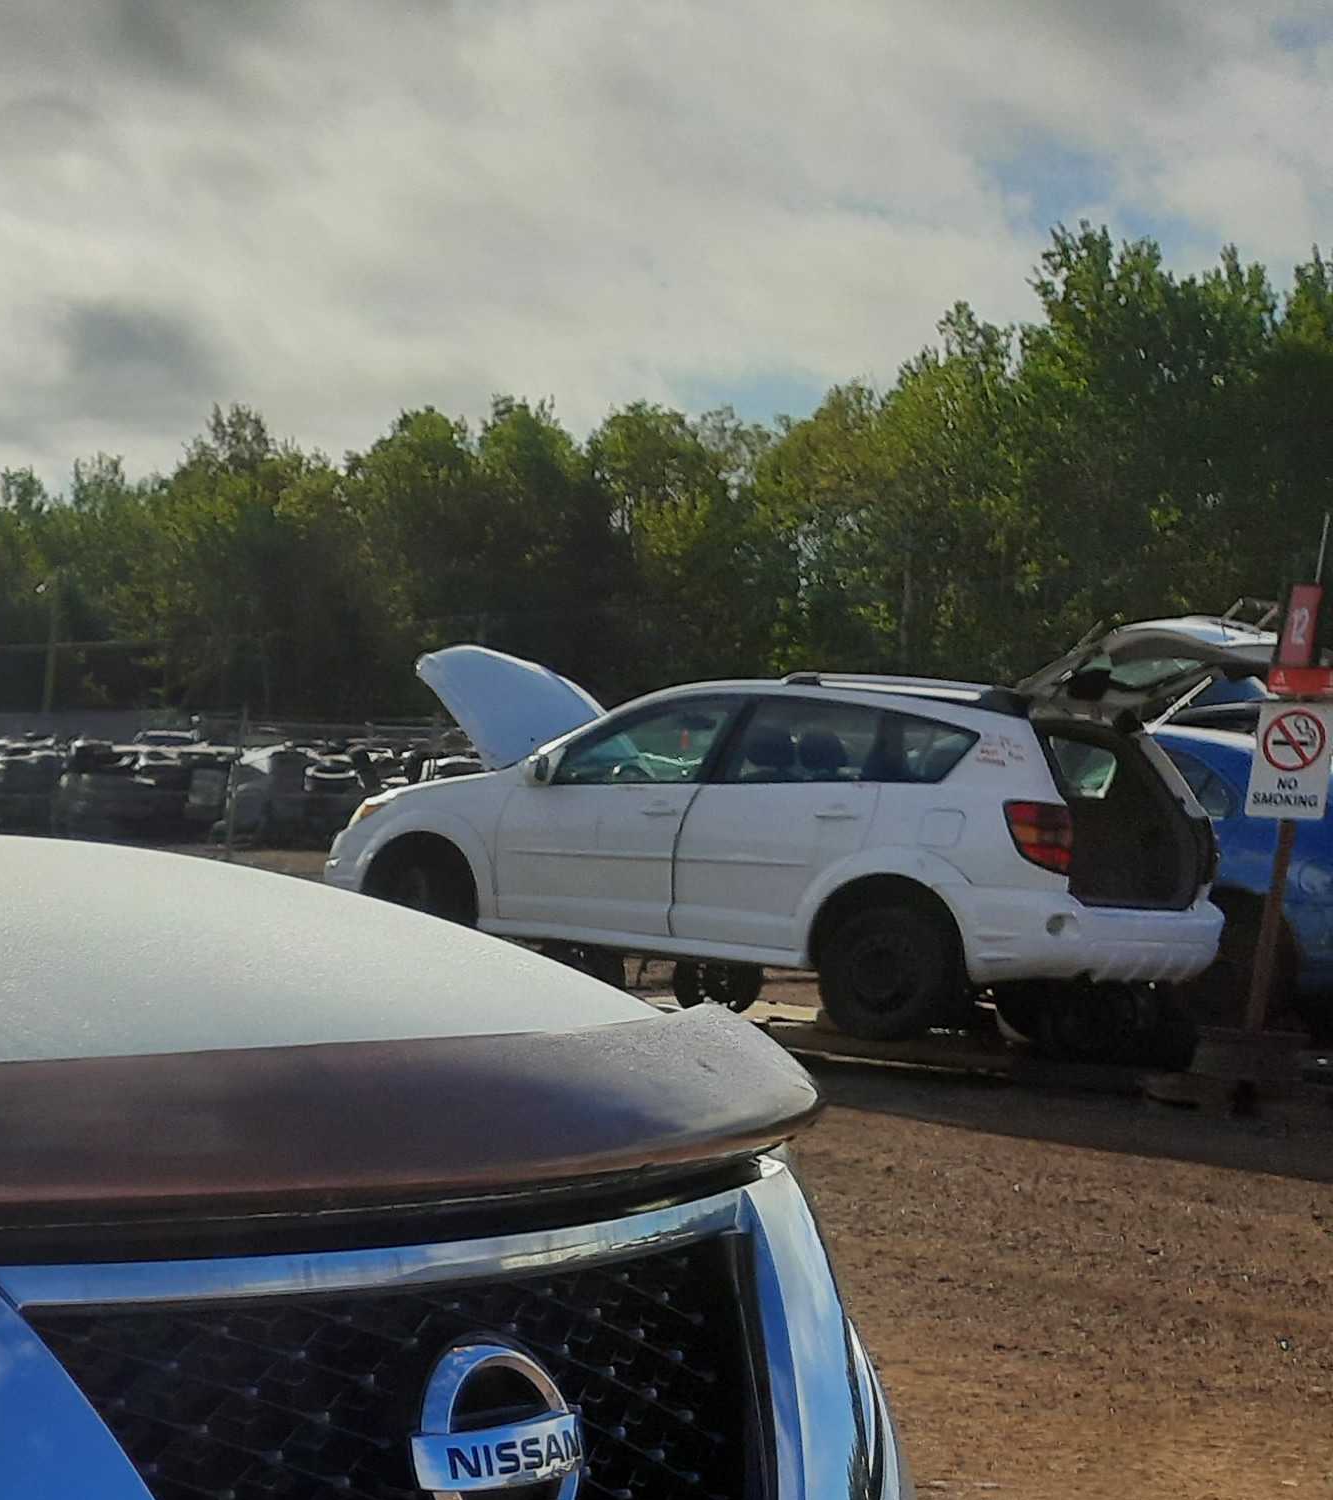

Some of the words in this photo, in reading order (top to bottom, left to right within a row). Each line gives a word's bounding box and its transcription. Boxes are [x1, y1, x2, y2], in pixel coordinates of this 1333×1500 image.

[1290, 607, 1310, 646] 12
[1276, 776, 1300, 791] NO
[1251, 791, 1319, 809] SMOKING
[445, 1425, 582, 1481] NISSAN
